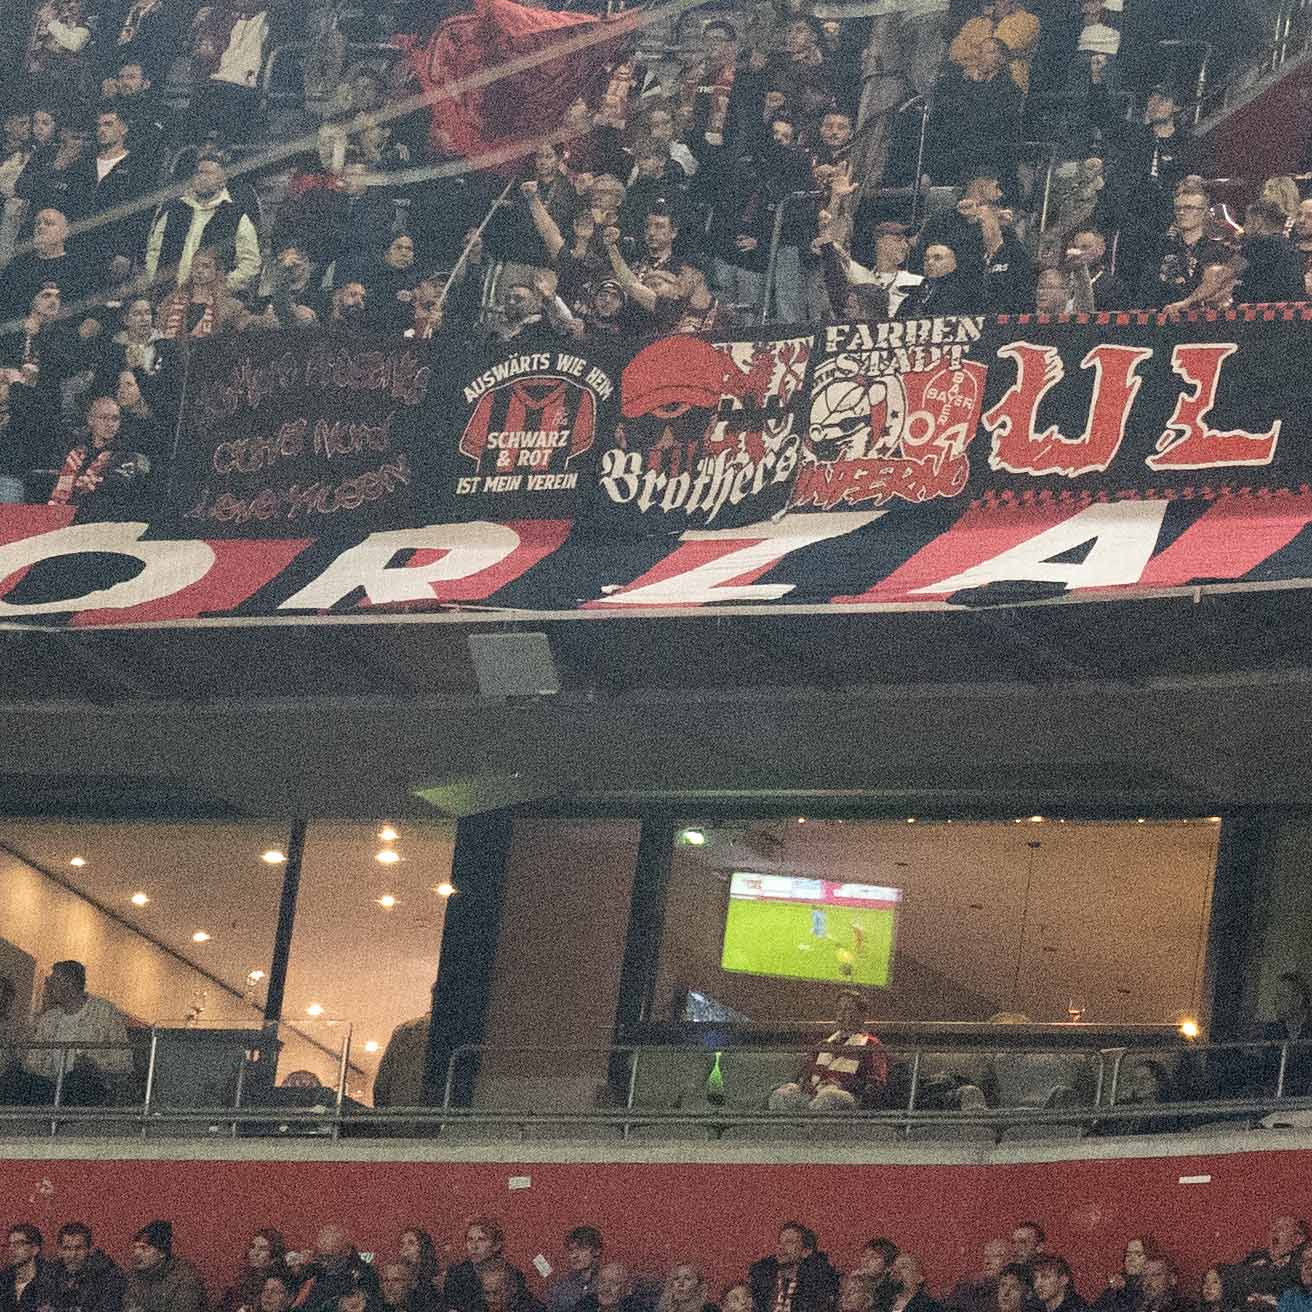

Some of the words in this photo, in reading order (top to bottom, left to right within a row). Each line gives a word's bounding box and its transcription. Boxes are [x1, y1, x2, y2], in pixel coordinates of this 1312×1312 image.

[826, 316, 985, 352] FARBEN
[836, 344, 970, 377] STADT
[463, 352, 551, 403] AUSWÄRTS
[557, 353, 587, 377] WIE
[585, 366, 615, 401] HEIM
[487, 430, 571, 450] SCHWARZ
[496, 449, 512, 467] &
[517, 448, 554, 467] ROT
[456, 477, 481, 495] IST
[483, 474, 523, 493] MEIN
[527, 472, 579, 491] VEREIN
